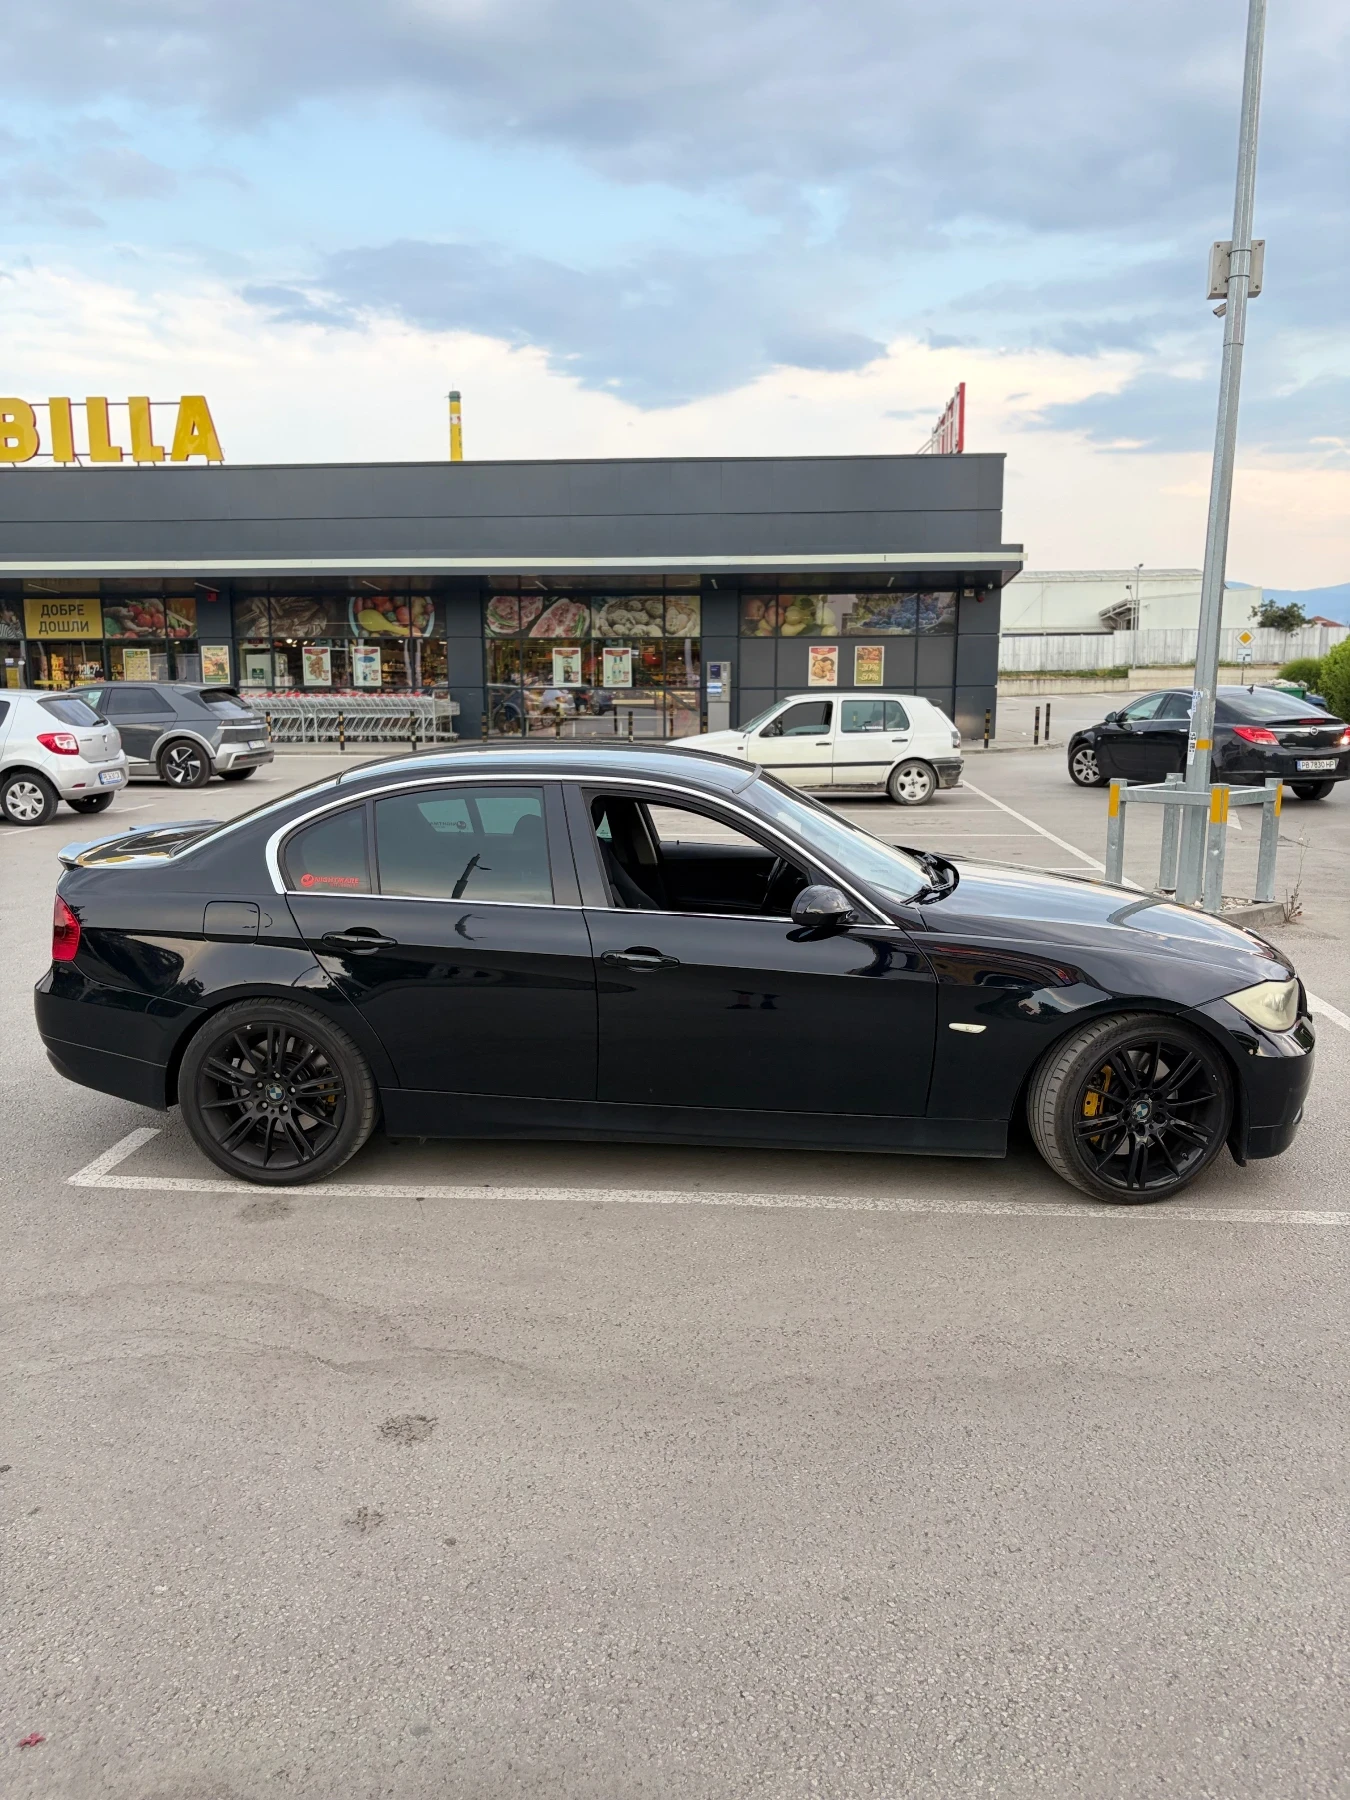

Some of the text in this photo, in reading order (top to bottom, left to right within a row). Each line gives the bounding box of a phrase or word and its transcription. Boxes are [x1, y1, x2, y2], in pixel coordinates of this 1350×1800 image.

[0, 395, 225, 463] BILLA
[40, 604, 85, 618] ДОБРЕ
[38, 620, 90, 635] ДОШЛИ
[314, 876, 360, 884] NIGHTMARE
